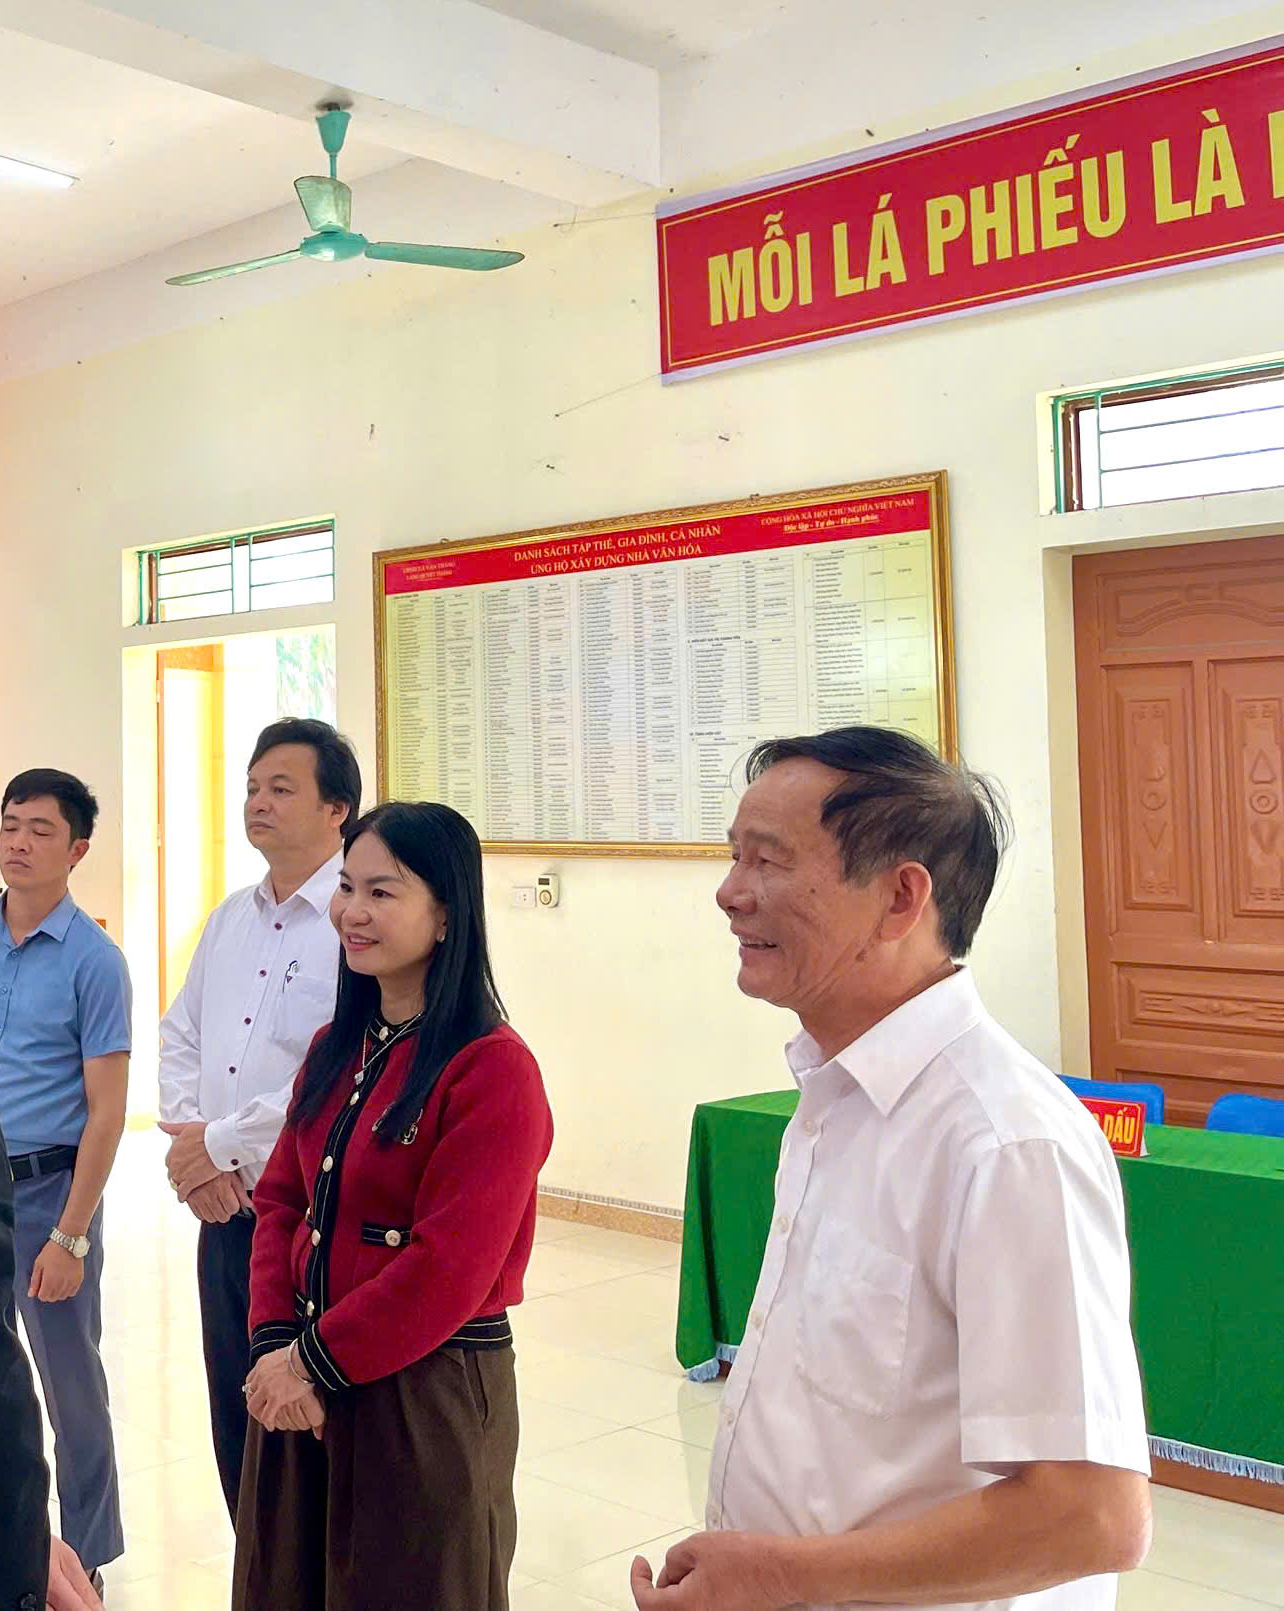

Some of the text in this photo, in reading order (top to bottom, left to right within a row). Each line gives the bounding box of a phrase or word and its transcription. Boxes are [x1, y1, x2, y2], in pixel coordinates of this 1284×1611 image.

[708, 211, 812, 326] MỖI
[832, 193, 908, 297] LÁ
[926, 134, 1126, 277] PHIẾU
[1151, 108, 1245, 224] LÀ
[894, 498, 915, 508] NAM
[514, 550, 542, 561] DANH
[544, 545, 570, 558] SÁCH
[572, 542, 592, 555] TẬP
[618, 535, 637, 548] GIA
[671, 529, 686, 541] CÁ
[688, 525, 721, 538] NHÂN
[554, 559, 569, 572] HỘ
[570, 556, 593, 569] XÂY
[594, 553, 625, 567] DỰNG
[626, 550, 650, 563] NHÀ
[652, 546, 677, 559] VĂN
[678, 543, 702, 556] HÓA
[1105, 1108, 1135, 1144] DẤU
